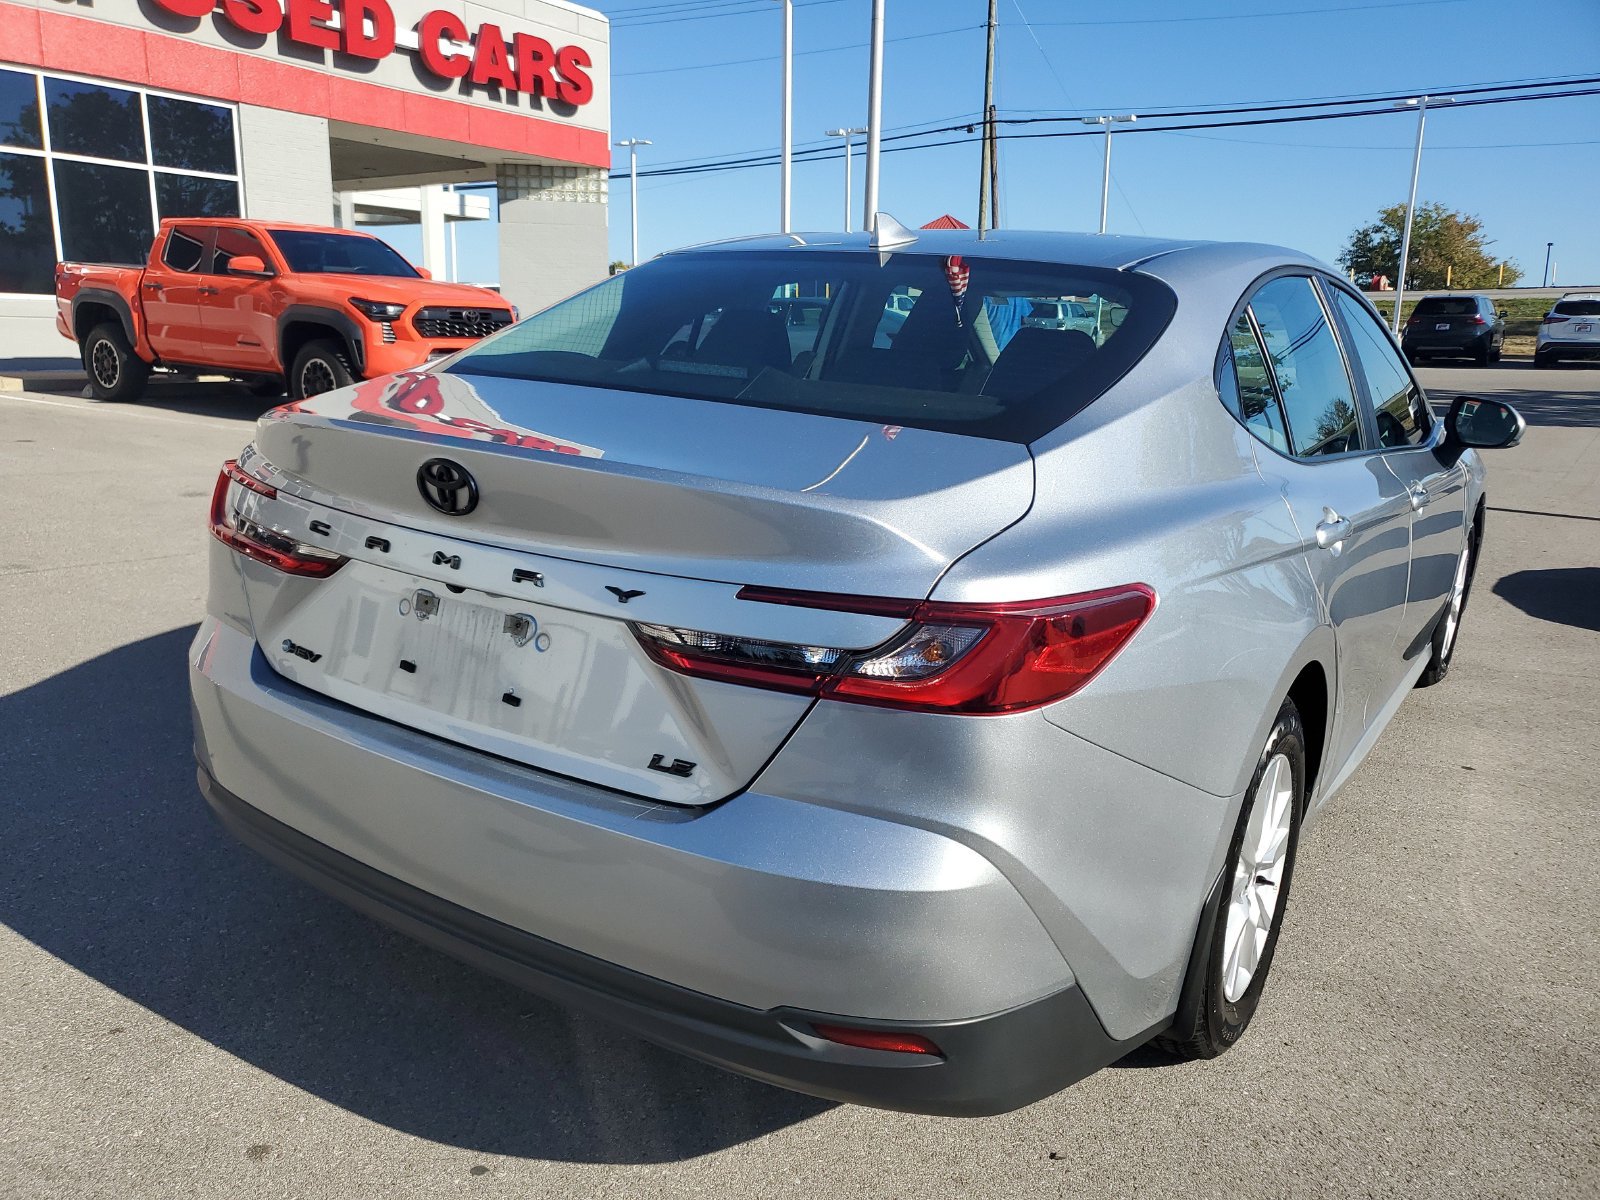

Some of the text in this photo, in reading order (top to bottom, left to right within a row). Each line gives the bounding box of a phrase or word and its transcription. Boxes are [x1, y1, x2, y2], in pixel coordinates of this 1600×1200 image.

[152, 0, 594, 106] SED CARS
[309, 519, 647, 604] CAMRY
[646, 753, 697, 778] LE
